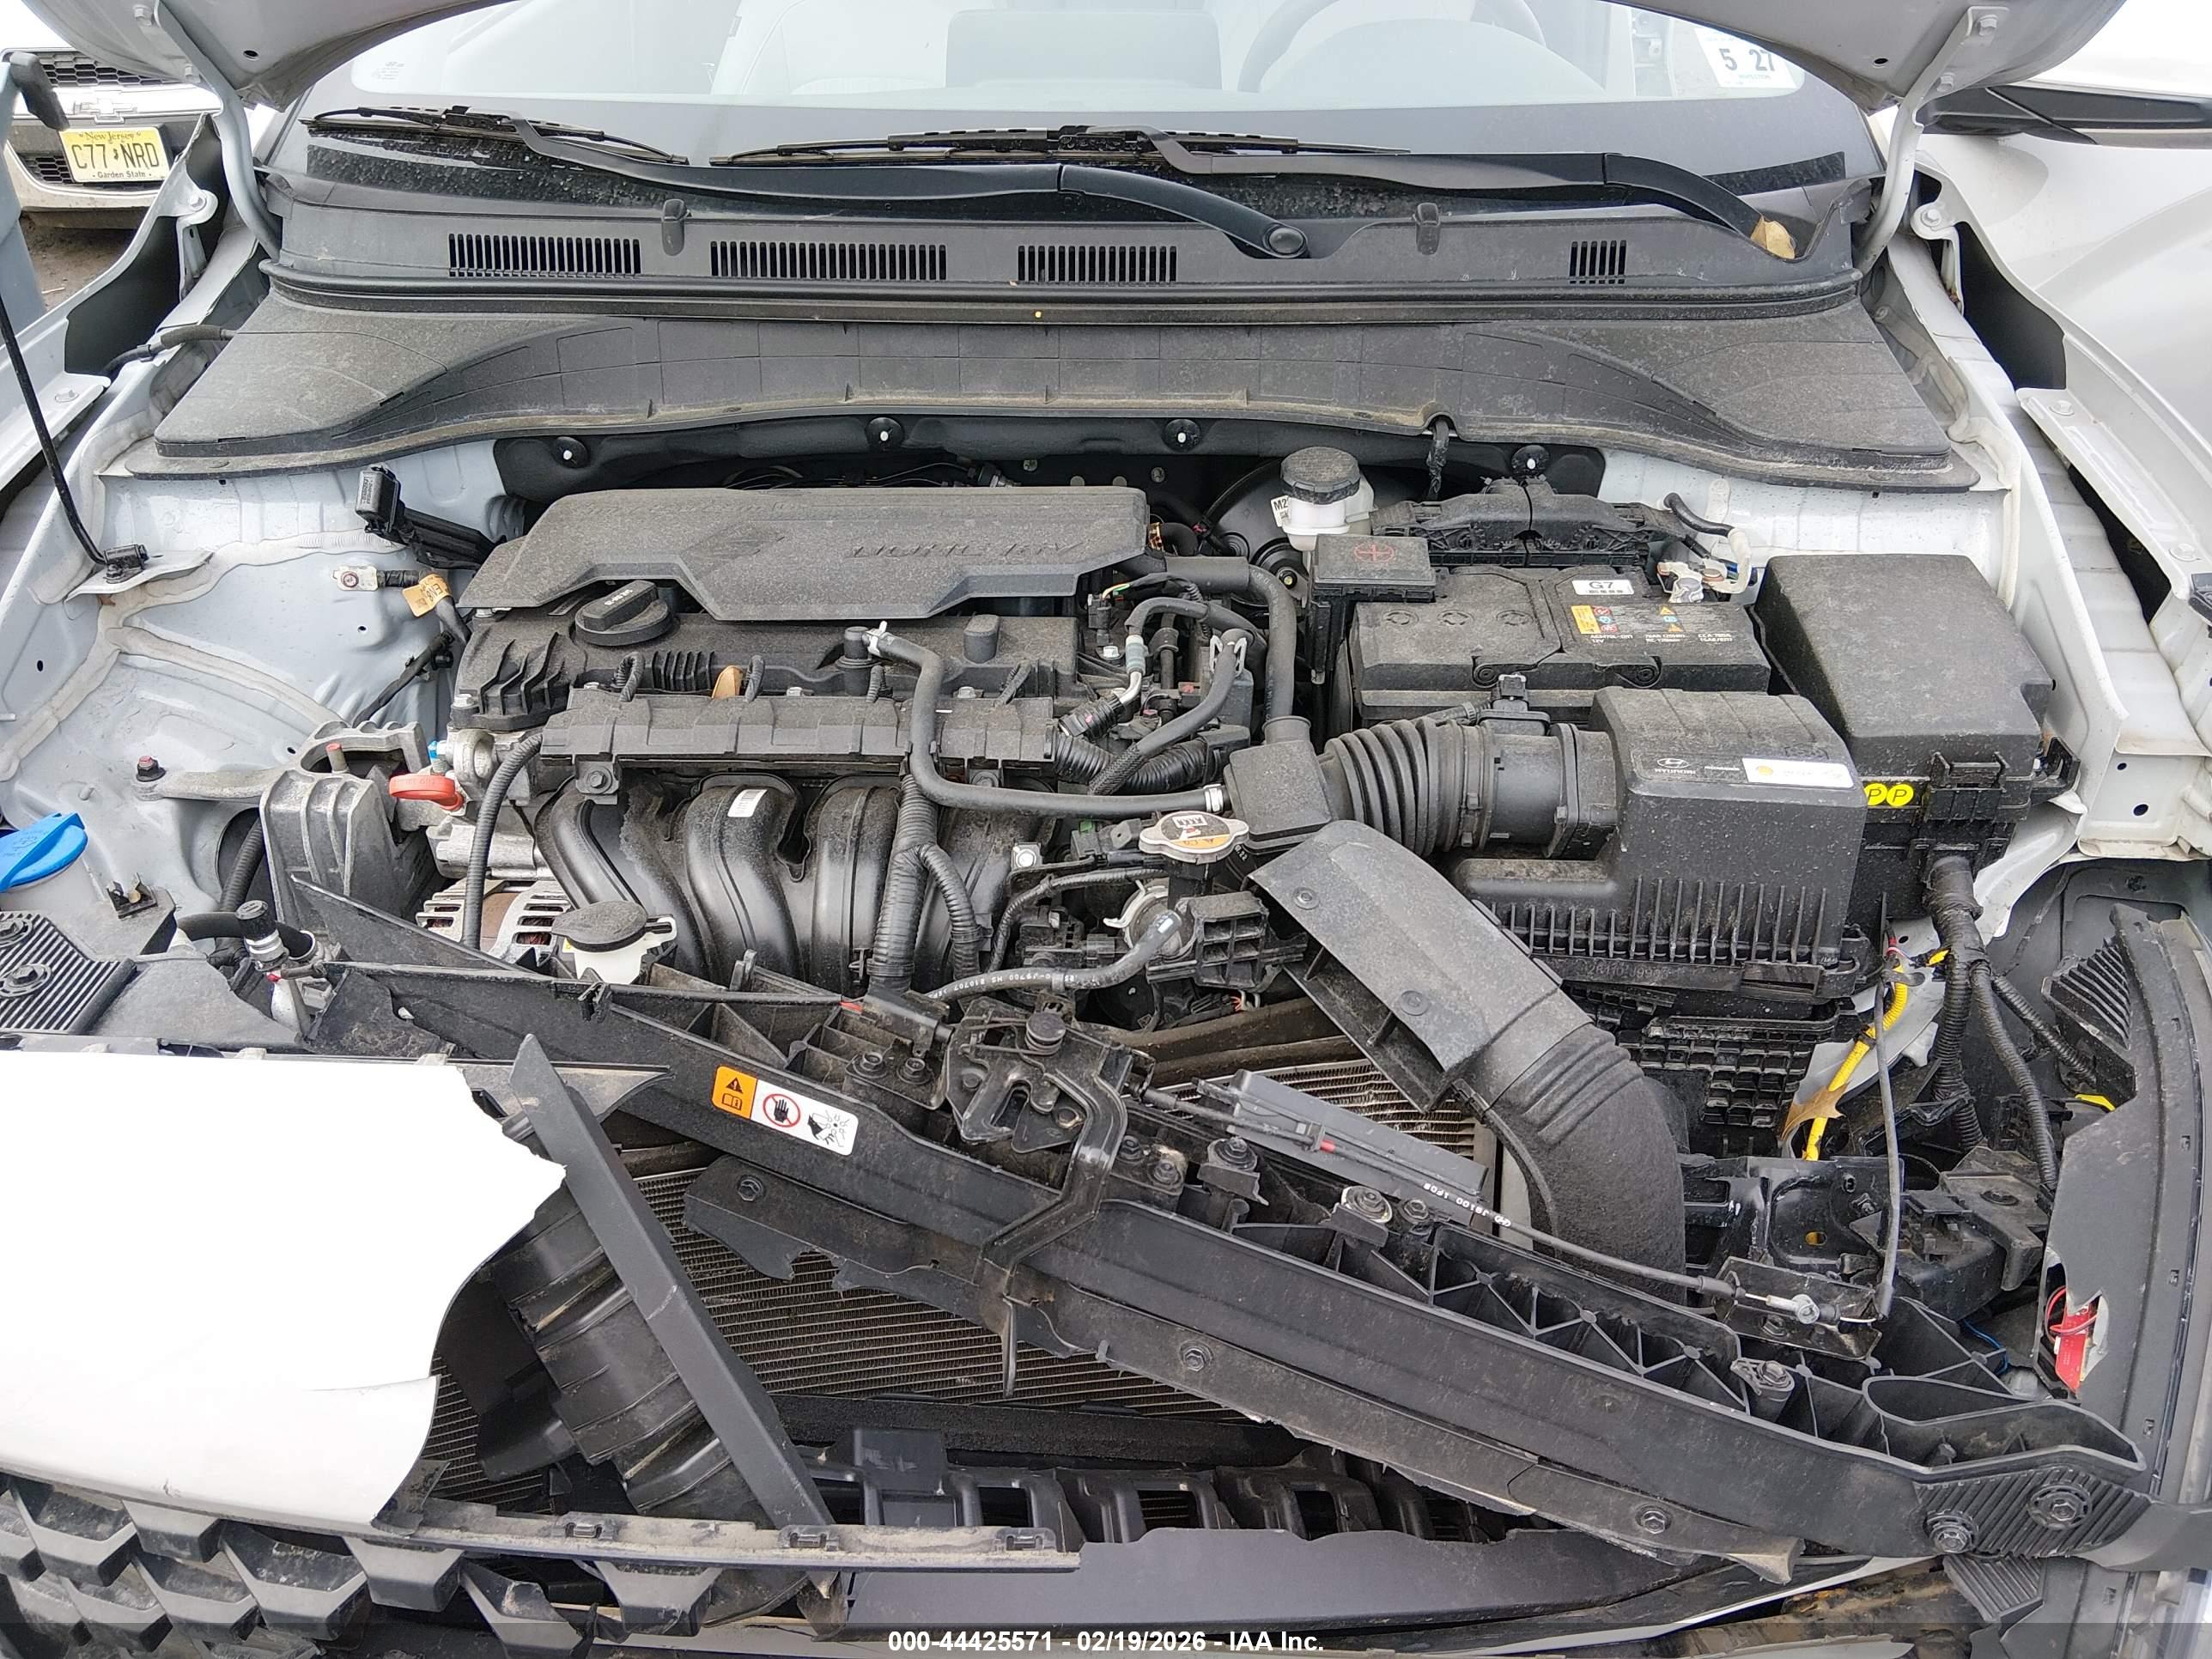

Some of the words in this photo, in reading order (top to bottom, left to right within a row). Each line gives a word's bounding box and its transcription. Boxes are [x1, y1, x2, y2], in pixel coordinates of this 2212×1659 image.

[1718, 48, 1738, 71] 5
[1748, 48, 1776, 72] 27
[84, 131, 106, 141] New
[106, 131, 136, 144] Jersey
[71, 143, 108, 169] C77
[120, 143, 161, 169] NRD
[1273, 498, 1289, 511] M2
